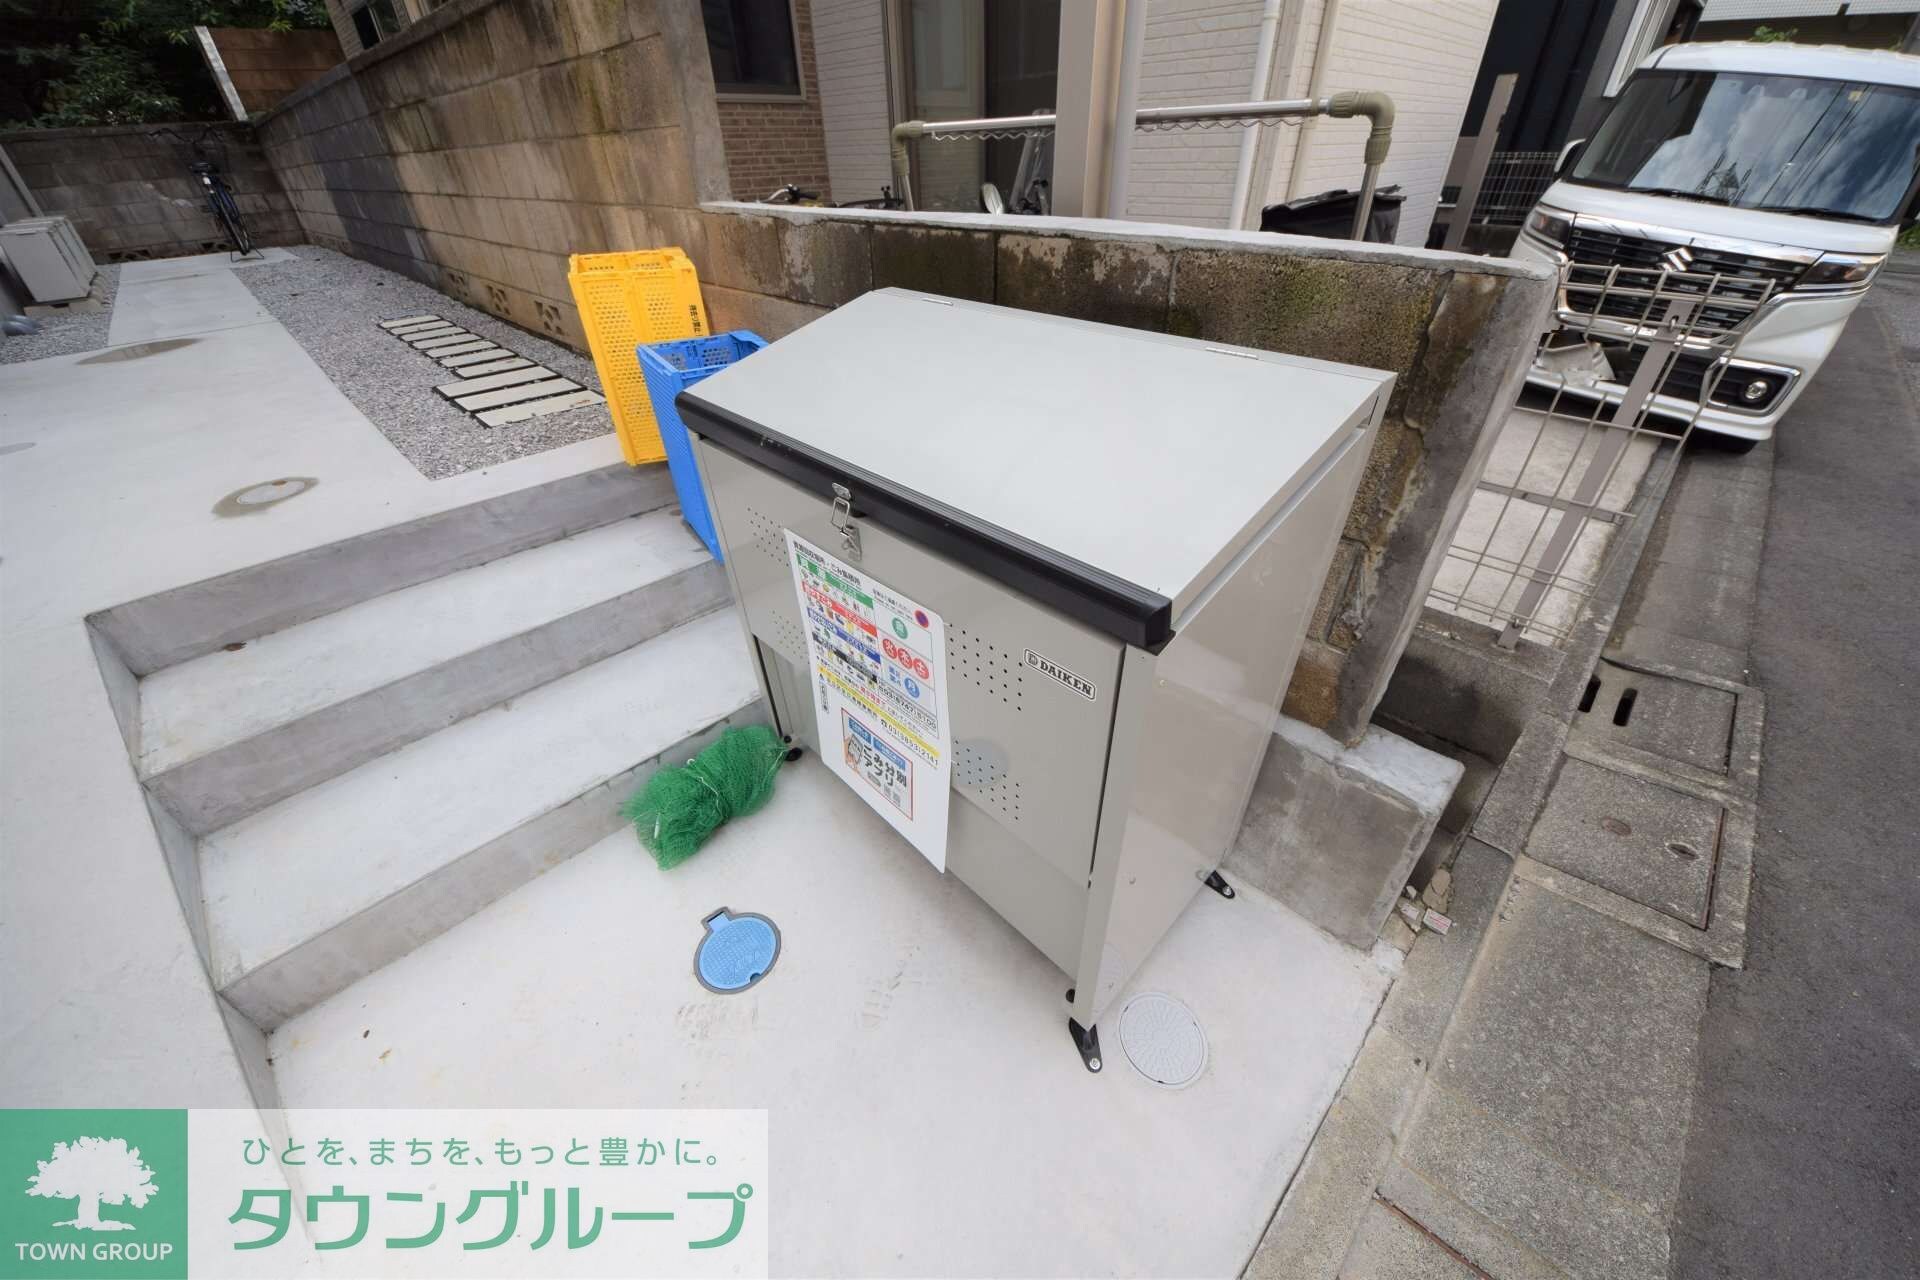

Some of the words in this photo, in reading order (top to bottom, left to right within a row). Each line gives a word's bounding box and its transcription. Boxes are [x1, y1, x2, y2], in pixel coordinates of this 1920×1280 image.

[1040, 660, 1092, 696] DAIKEN
[864, 744, 907, 788] ごみ分別
